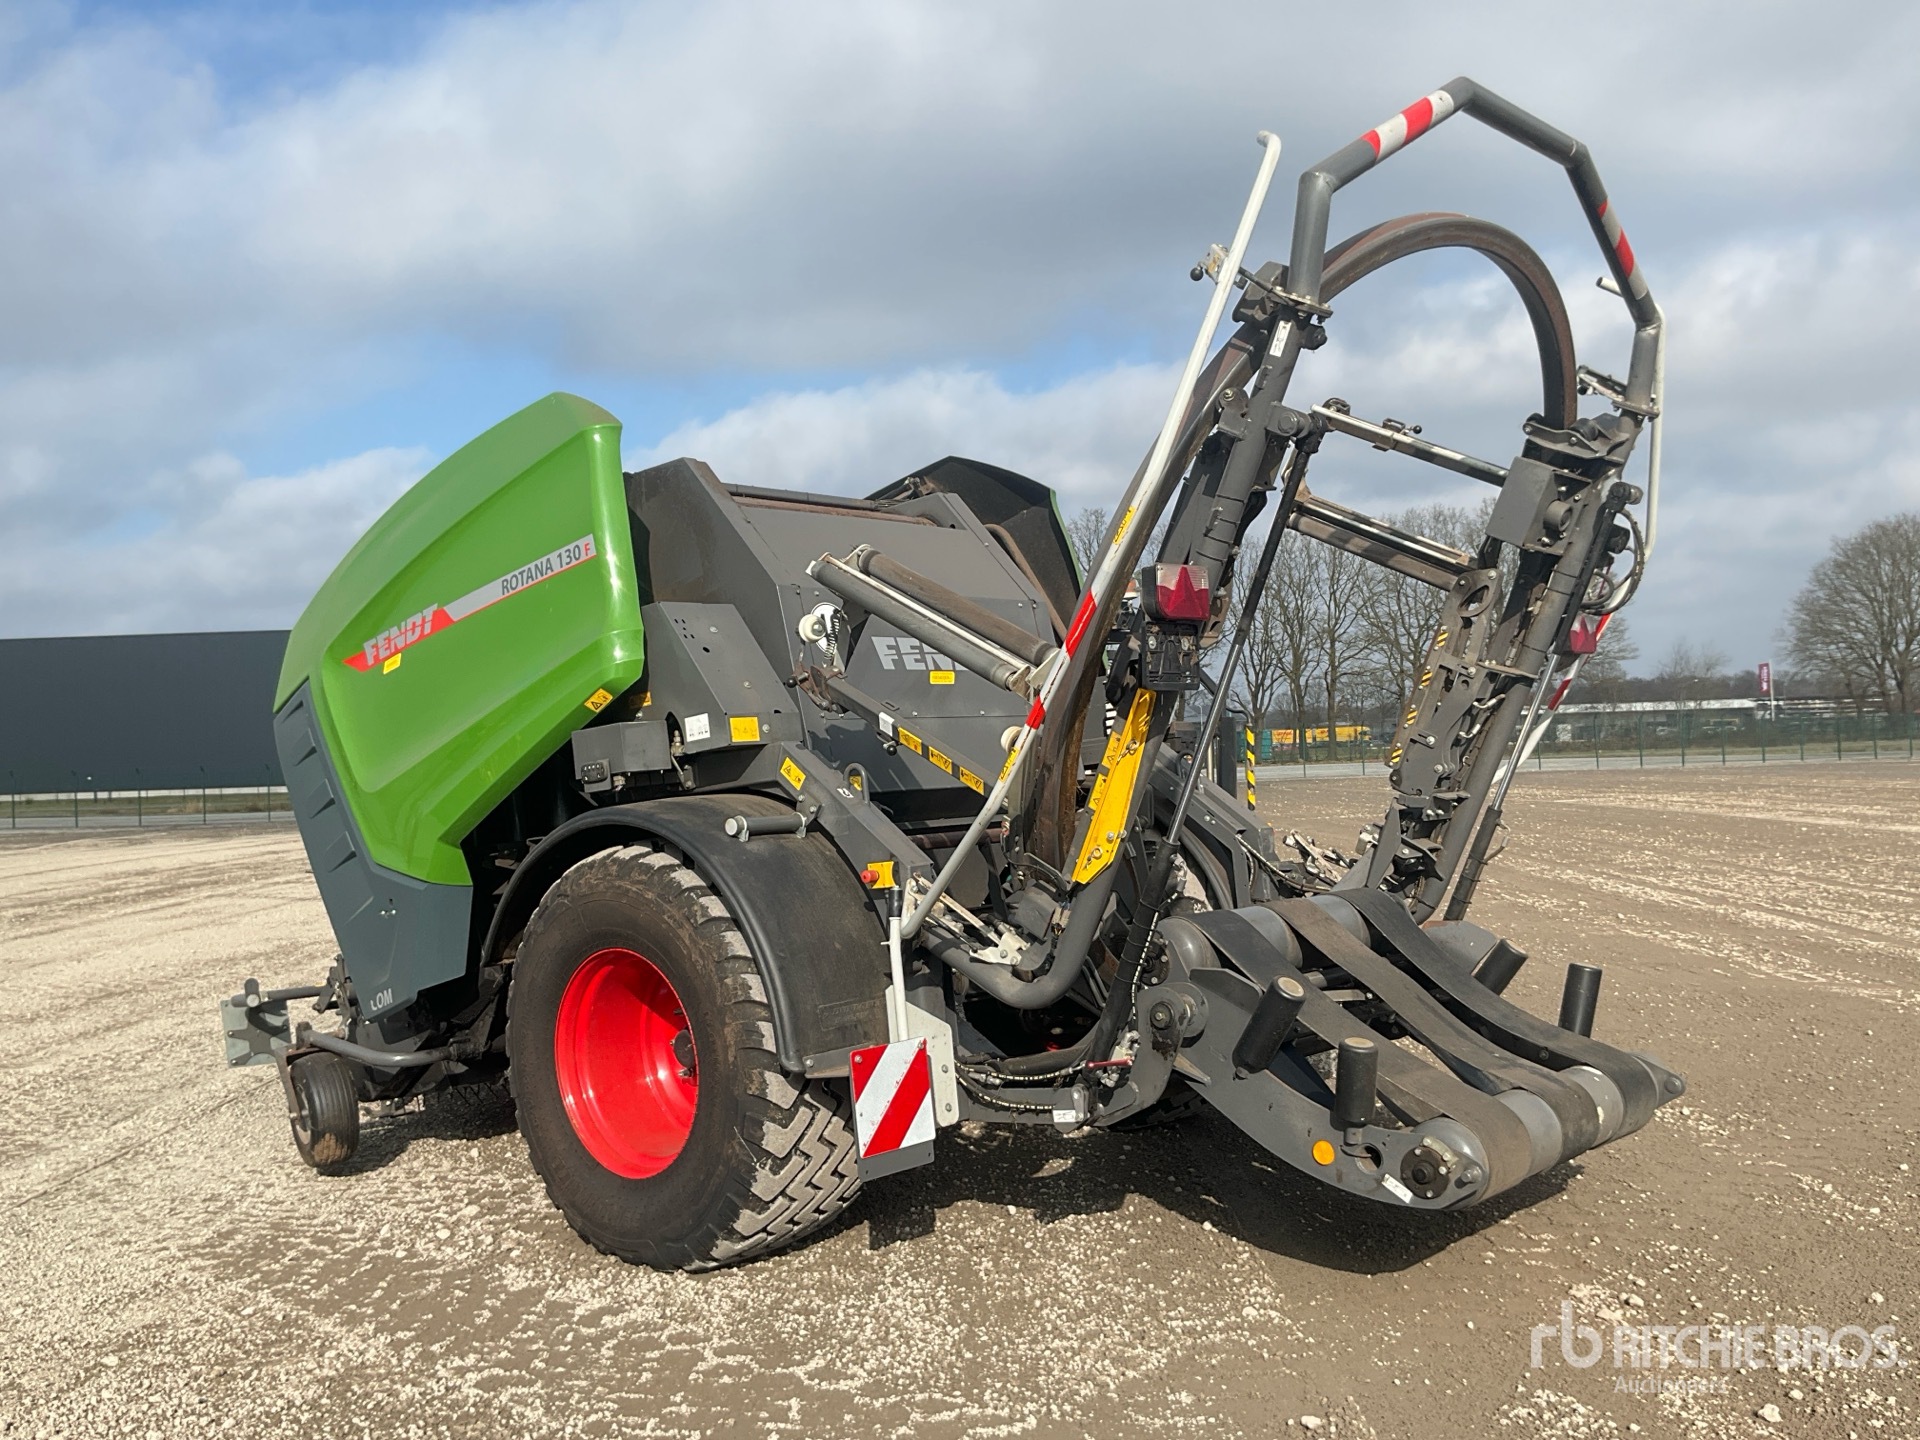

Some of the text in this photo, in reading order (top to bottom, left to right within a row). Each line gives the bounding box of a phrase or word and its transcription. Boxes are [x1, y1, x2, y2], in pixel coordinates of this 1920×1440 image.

[501, 542, 591, 596] ROTANA 130 F
[363, 603, 438, 666] FENDT
[871, 636, 969, 670] FEN
